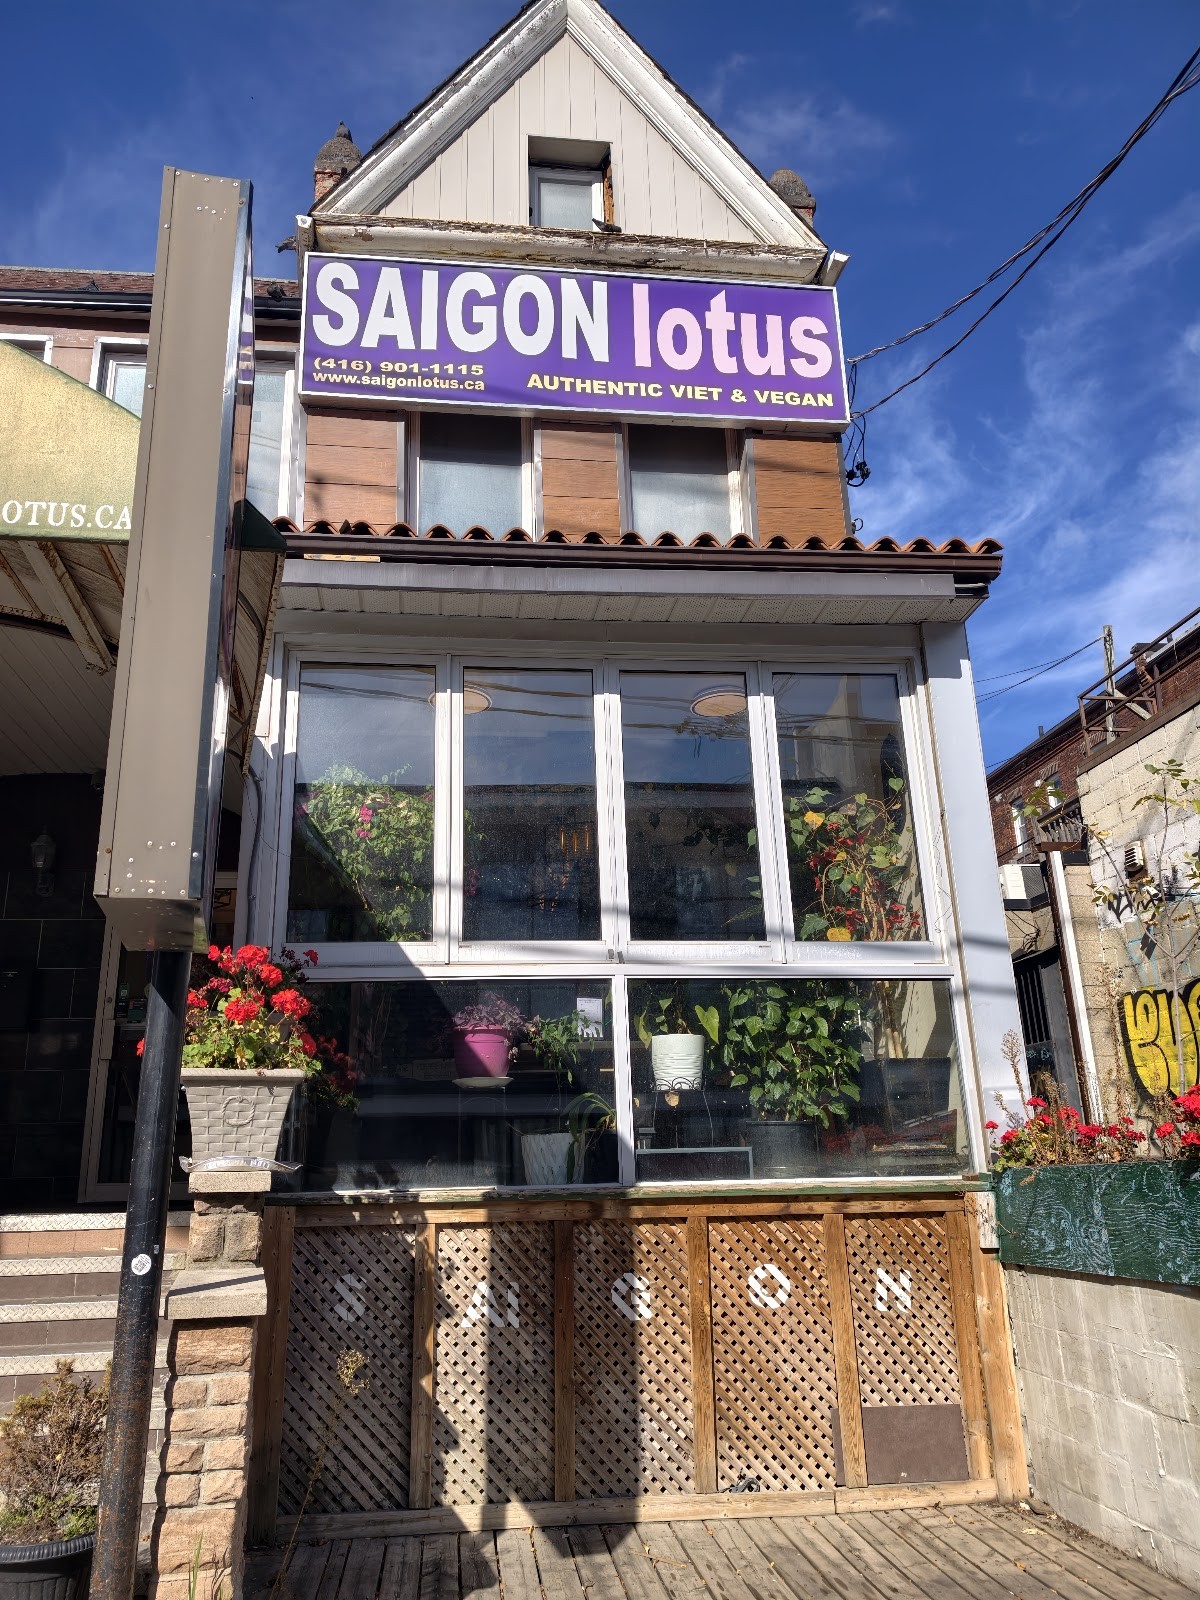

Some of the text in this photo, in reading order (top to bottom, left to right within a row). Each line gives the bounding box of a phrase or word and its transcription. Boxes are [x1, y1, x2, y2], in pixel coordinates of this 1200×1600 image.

[312, 262, 833, 378] SAIGON lotus
[313, 357, 484, 376] (416) 901-1115
[313, 372, 485, 391] www.saigonlotus.ca
[527, 373, 834, 408] AUTHENTIC VIET & VEGAN
